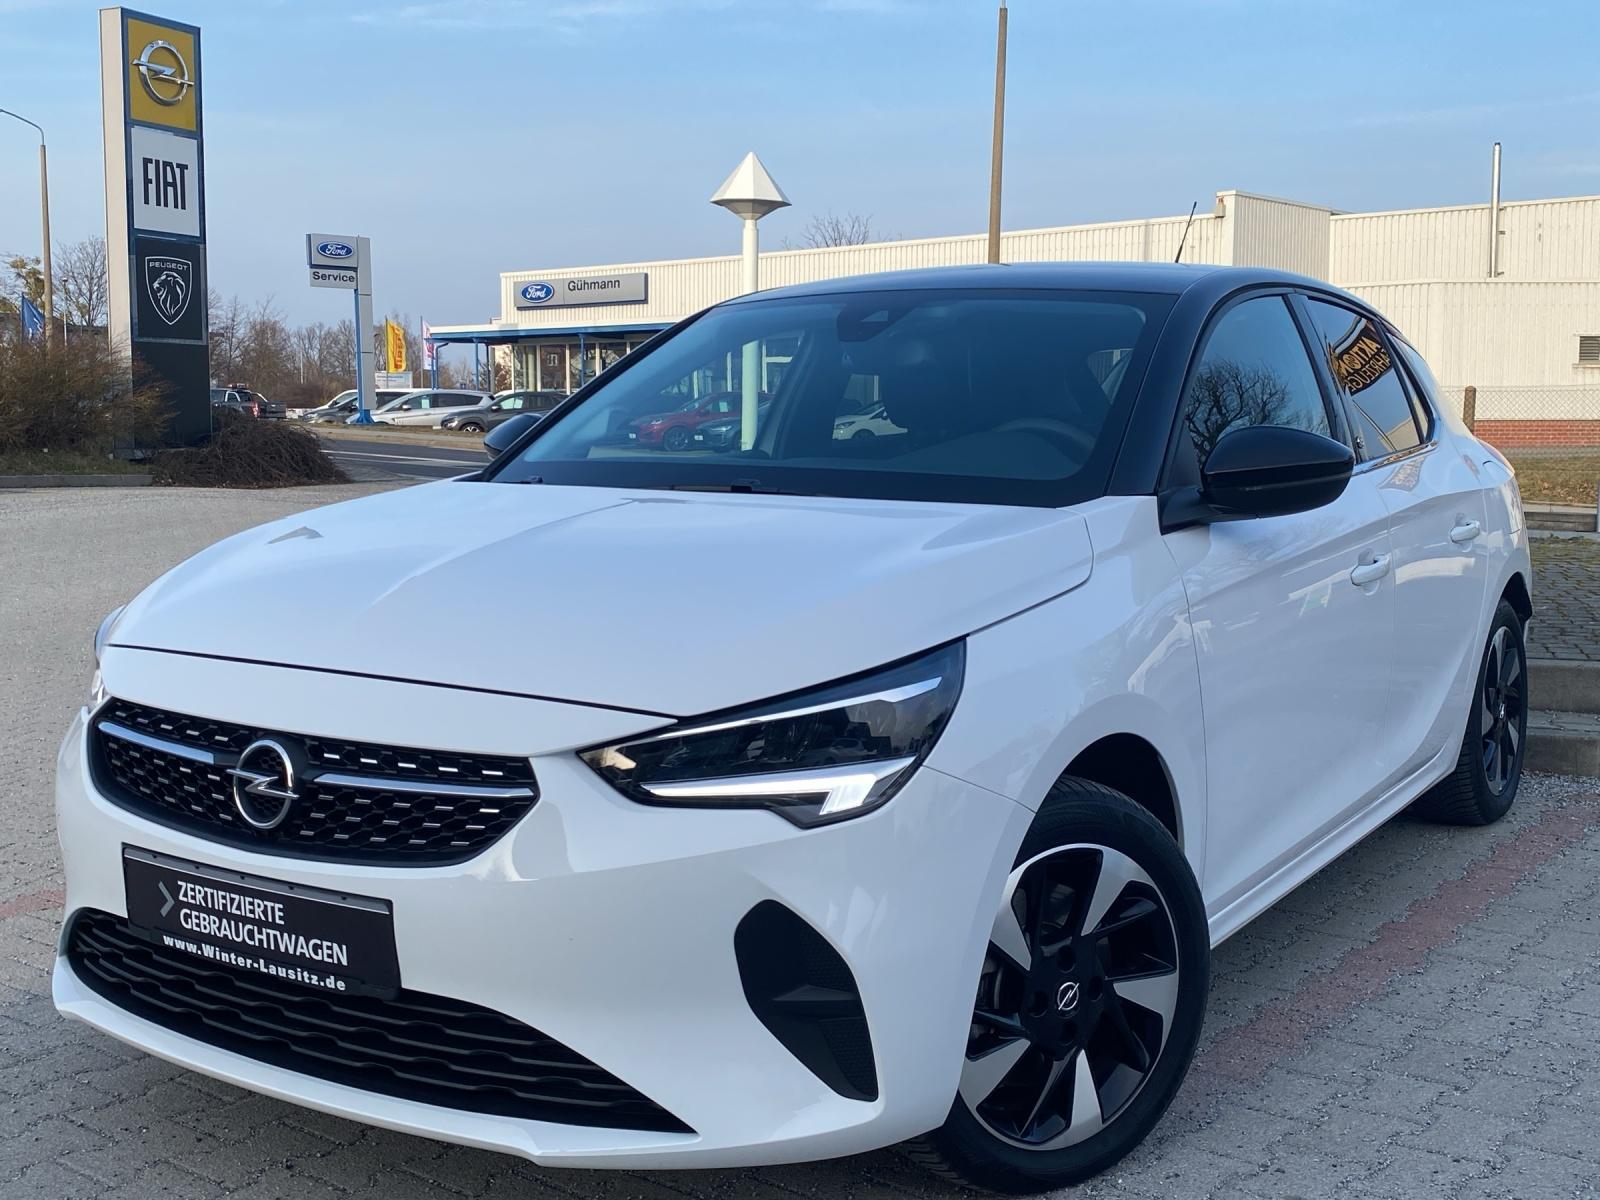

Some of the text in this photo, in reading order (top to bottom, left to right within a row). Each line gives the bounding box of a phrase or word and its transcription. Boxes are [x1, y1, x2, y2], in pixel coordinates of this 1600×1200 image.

[142, 156, 188, 211] FIAT
[325, 243, 348, 256] Ford
[149, 261, 188, 271] PEUGEOT
[312, 271, 356, 283] Service
[525, 279, 621, 299] Ford Gühmann
[177, 880, 285, 925] ZERTIFIZIERTE
[180, 908, 349, 966] GEBRAUCHTWAGEN
[163, 934, 347, 991] www.Winter-Lausitz.de
